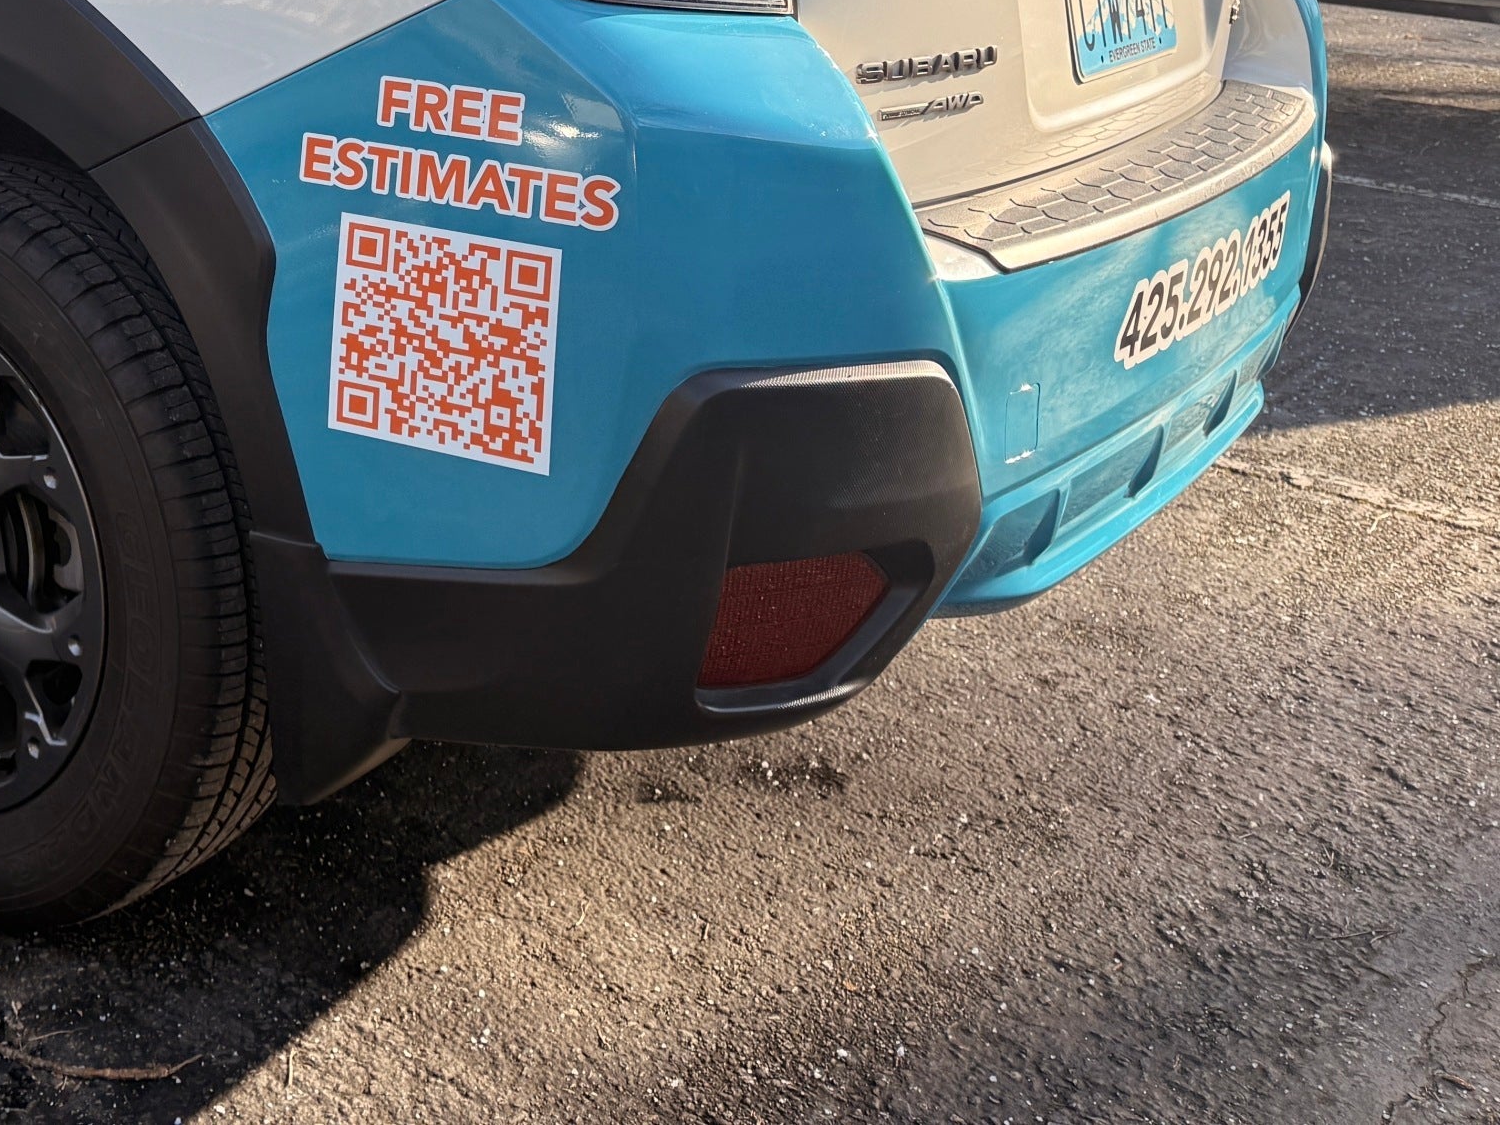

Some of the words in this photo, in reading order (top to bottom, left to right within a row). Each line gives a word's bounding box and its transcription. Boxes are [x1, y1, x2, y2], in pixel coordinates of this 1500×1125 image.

[856, 45, 997, 84] SUBARU
[1108, 41, 1140, 63] EVERGREEN
[1140, 36, 1156, 55] STATE
[380, 80, 522, 142] FREE
[925, 91, 984, 114] AWD
[303, 136, 617, 227] ESTIMATES
[1119, 201, 1288, 359] 425.292.1355
